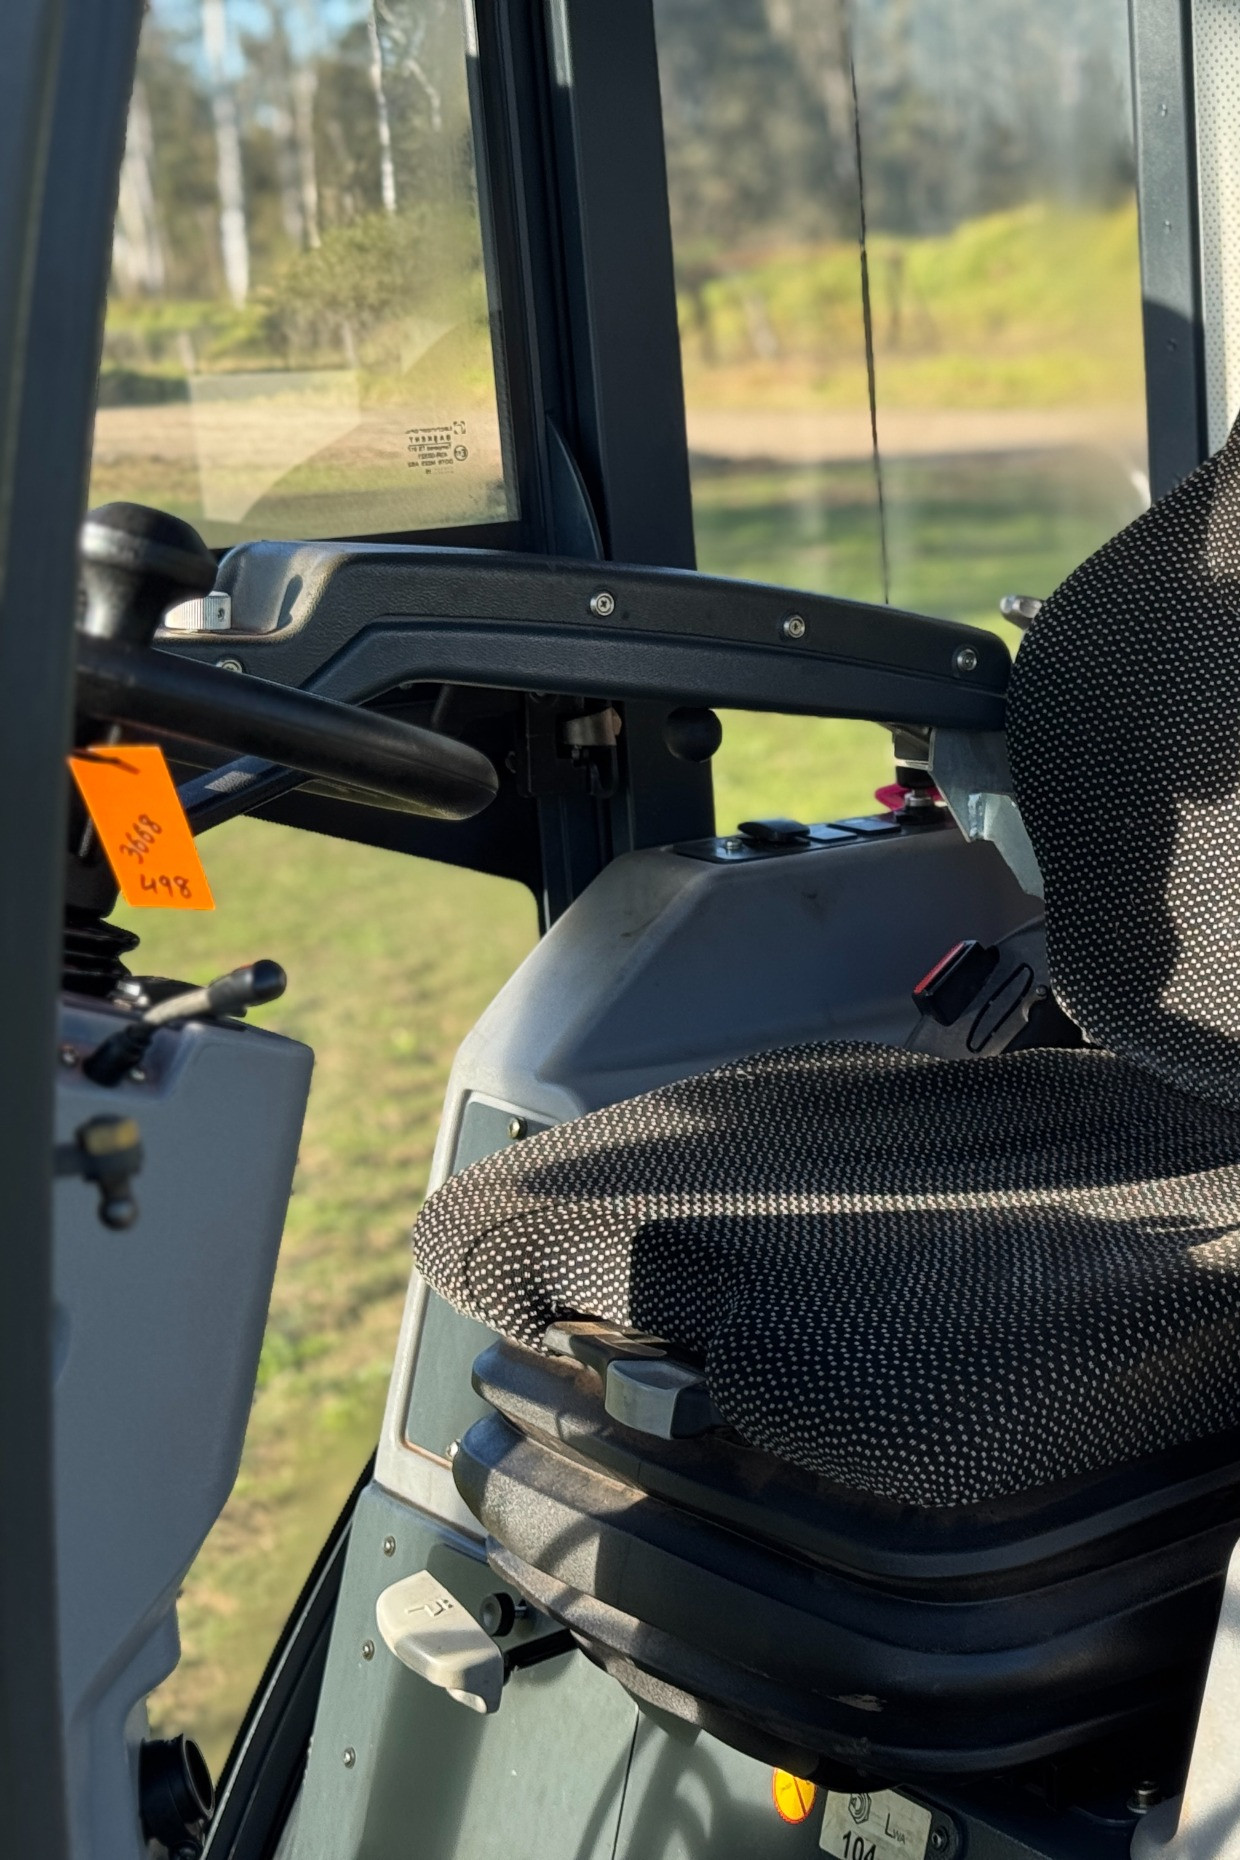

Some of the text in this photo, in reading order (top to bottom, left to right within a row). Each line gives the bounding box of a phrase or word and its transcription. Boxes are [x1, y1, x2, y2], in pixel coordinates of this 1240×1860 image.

[119, 813, 163, 865] 3668
[139, 873, 192, 900] 498
[842, 1830, 877, 1860] 104
